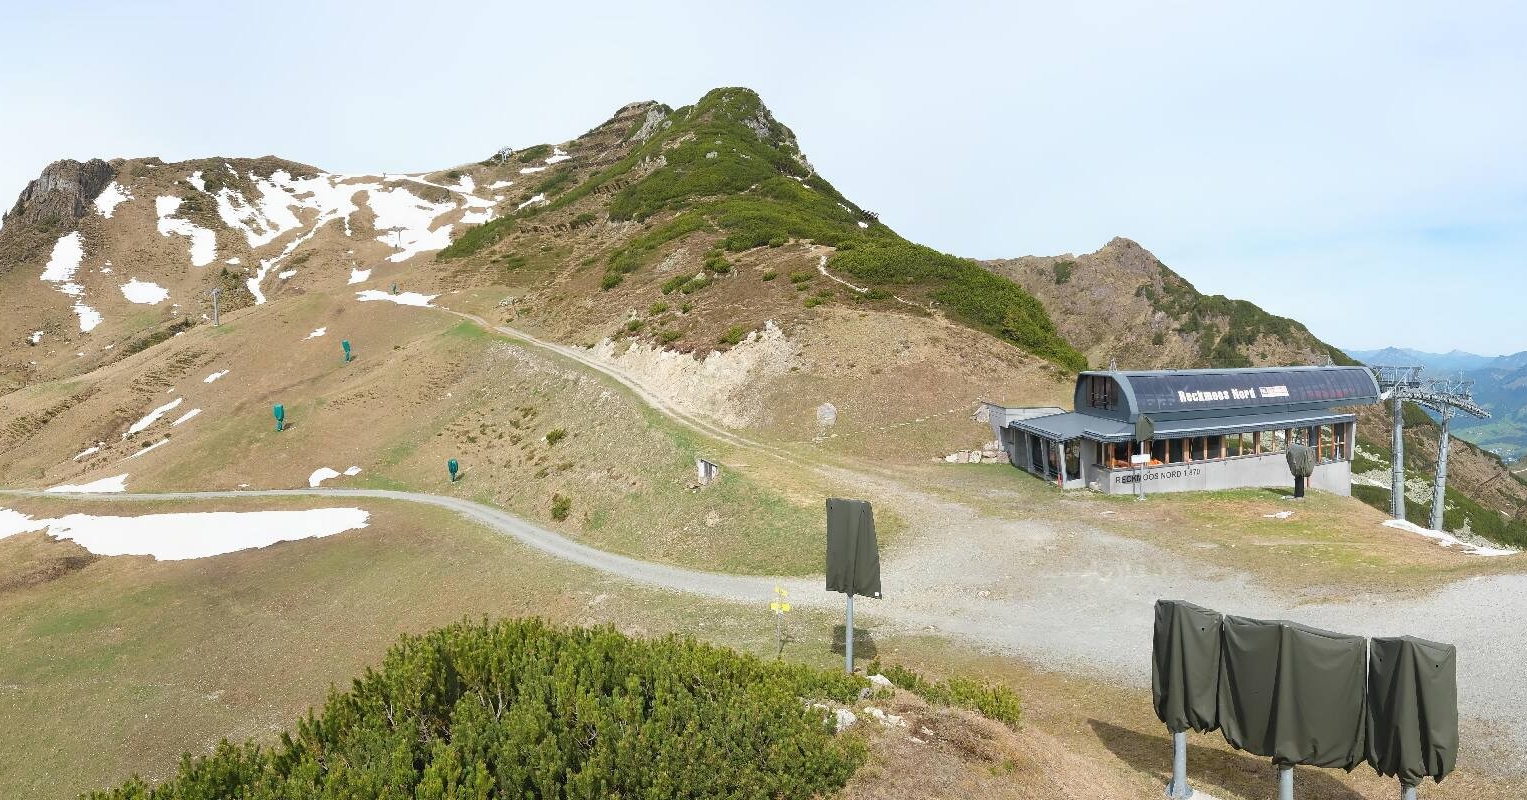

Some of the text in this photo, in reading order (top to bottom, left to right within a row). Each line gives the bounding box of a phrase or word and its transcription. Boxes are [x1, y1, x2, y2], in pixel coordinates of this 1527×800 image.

[1178, 390, 1230, 402] Reckmoos
[1231, 387, 1256, 400] Nord
[1160, 470, 1182, 479] NORD
